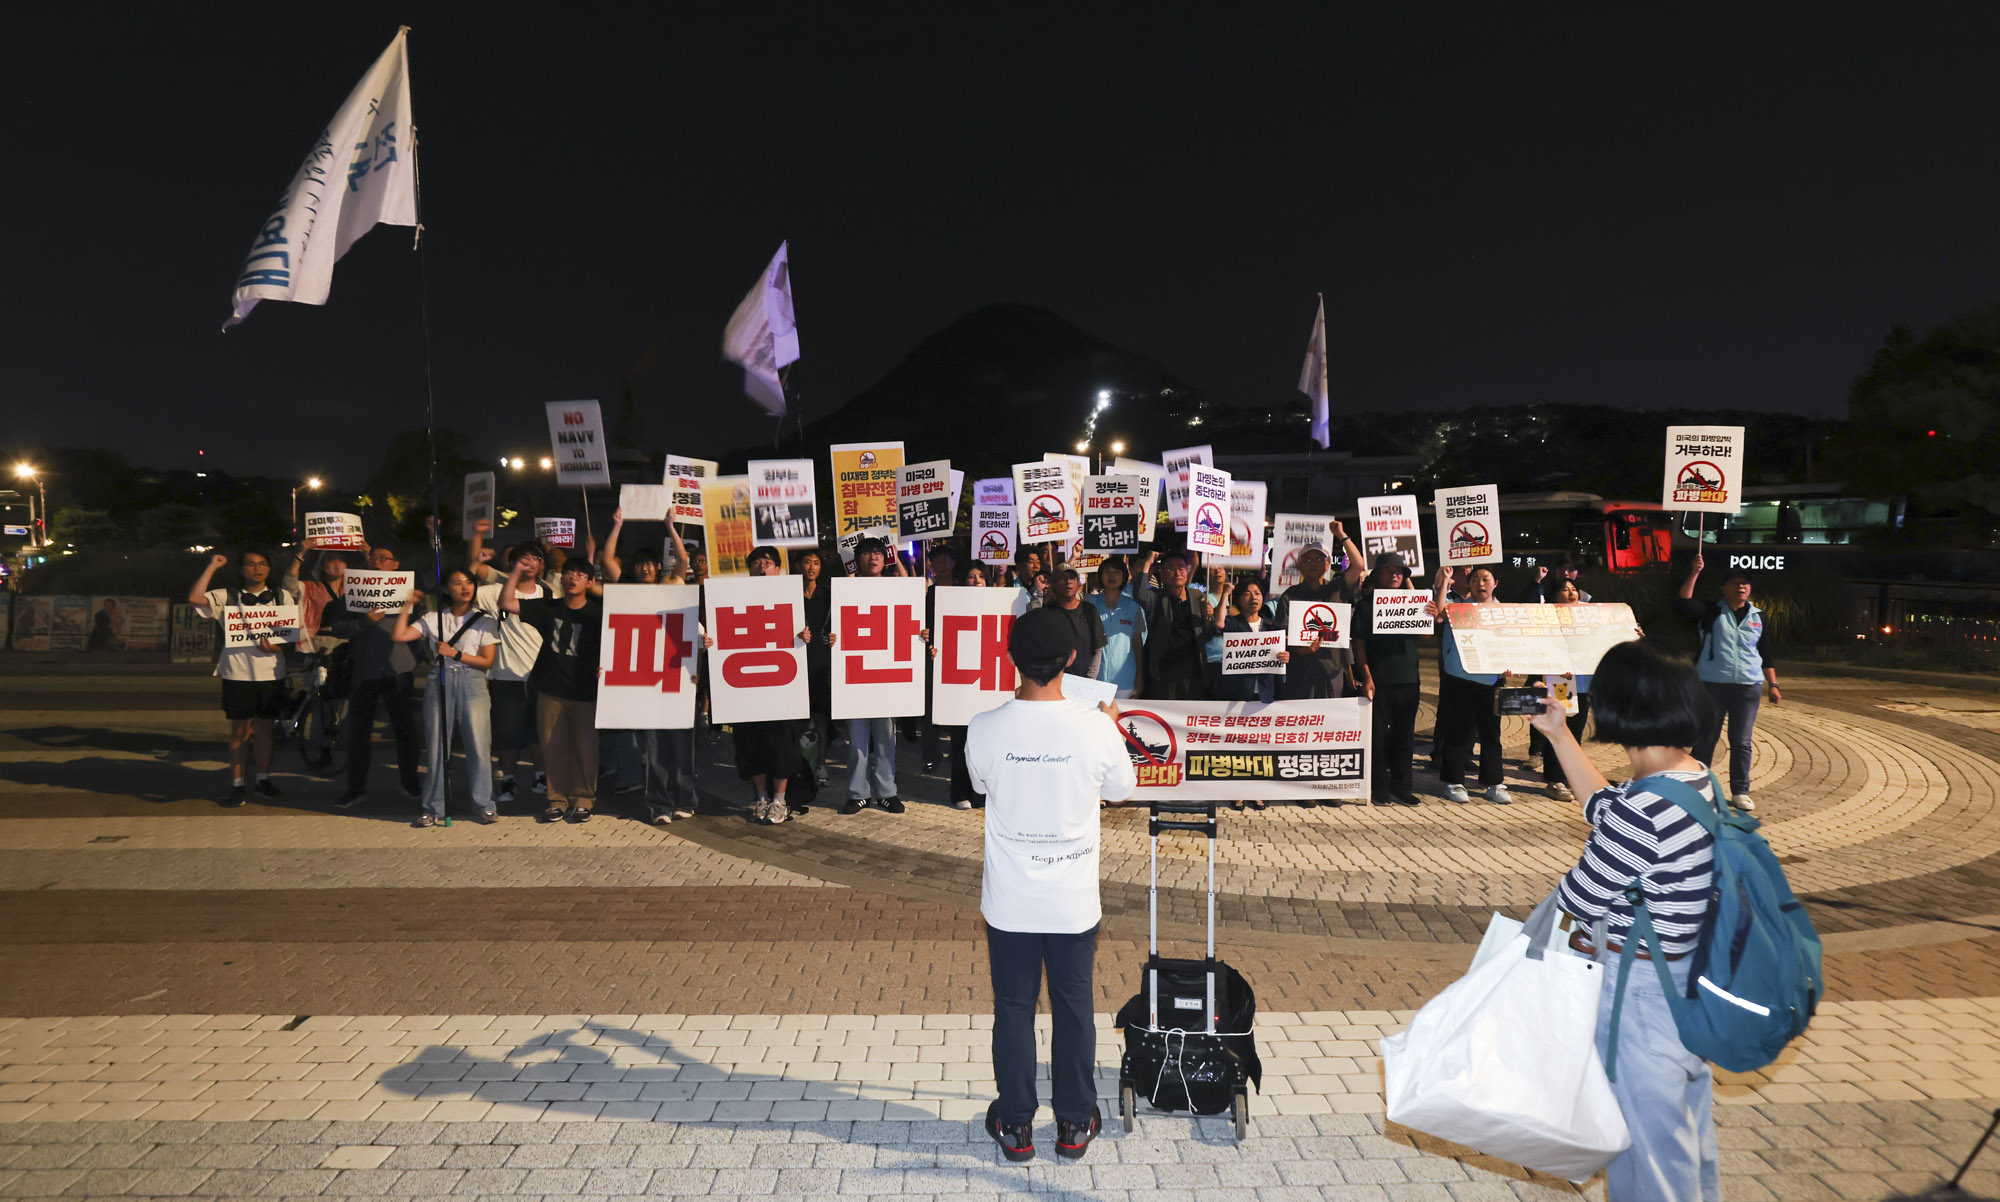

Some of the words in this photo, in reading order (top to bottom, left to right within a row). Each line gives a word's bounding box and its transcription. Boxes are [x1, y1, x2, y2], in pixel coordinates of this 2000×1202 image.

[563, 411, 584, 425] NO
[557, 430, 594, 444] NAVY
[572, 449, 585, 459] TO
[1675, 444, 1732, 457] 거부하라!
[841, 472, 869, 481] 이재명
[905, 468, 935, 482] 미국의
[1197, 472, 1226, 488] 파병논의
[901, 483, 921, 497] 파병
[923, 481, 944, 494] 압박
[1023, 480, 1065, 493] 중단하라!
[1095, 482, 1129, 494] 정부는
[1195, 485, 1226, 502] 중단하라!
[1675, 490, 1726, 503] 파병반대
[1089, 497, 1111, 509] 파병
[1112, 497, 1135, 508] 요구
[1446, 494, 1487, 507] 파병논의
[902, 502, 929, 520] 규탄
[980, 511, 1010, 520] 파병논의
[1370, 505, 1402, 517] 미국의
[1446, 506, 1489, 519] 중단하라!
[913, 513, 946, 533] 한다!
[979, 520, 1010, 528] 중단하라!
[1028, 521, 1068, 535] 파병반대
[1088, 516, 1117, 532] 거부
[1366, 520, 1388, 532] 파병
[1391, 519, 1412, 530] 압박
[1099, 530, 1135, 547] 하라!
[1194, 531, 1225, 547] 파병반대
[1368, 537, 1398, 555] 규탄
[1450, 545, 1492, 559] 파병반대
[979, 551, 1009, 559] 파병반대
[1398, 549, 1417, 567] 다!
[1730, 555, 1785, 570] POLICE
[347, 576, 361, 585] DO
[363, 577, 384, 585] NOT
[384, 577, 407, 586] JOIN
[357, 589, 381, 597] WAR
[382, 589, 396, 597] OF
[1376, 596, 1389, 605] DO
[1390, 596, 1407, 604] NOT
[1408, 595, 1428, 604] JOIN
[228, 611, 242, 620] NO
[245, 610, 278, 619] NAVAL
[1377, 609, 1383, 617] A
[1385, 608, 1405, 617] WAR
[1407, 608, 1418, 616] OF
[1479, 607, 1530, 625] 호르무즈
[229, 619, 296, 632] DEPLOYMENT
[1377, 620, 1432, 630] AGGRESSION!
[231, 634, 244, 642] TO
[841, 604, 920, 685] 반
[1240, 638, 1258, 647] NOT
[1260, 636, 1280, 646] JOIN
[716, 603, 798, 689] 병
[604, 613, 693, 693] 파
[941, 614, 1017, 692] 대
[1235, 650, 1255, 659] WAR
[1258, 649, 1271, 657] OF
[1226, 660, 1284, 671] AGGRESSION!
[1186, 715, 1221, 727] 미국은
[1224, 715, 1272, 727] 침략전쟁
[1274, 715, 1325, 727] 중단하라!
[1186, 732, 1221, 743] 정부는
[1224, 732, 1272, 744] 파병압박
[1274, 732, 1308, 744] 단호히
[1312, 731, 1361, 743] 거부하라!
[1189, 755, 1274, 777] 파병반대
[1277, 754, 1361, 778] 평화행진
[1139, 765, 1178, 786] 반대
